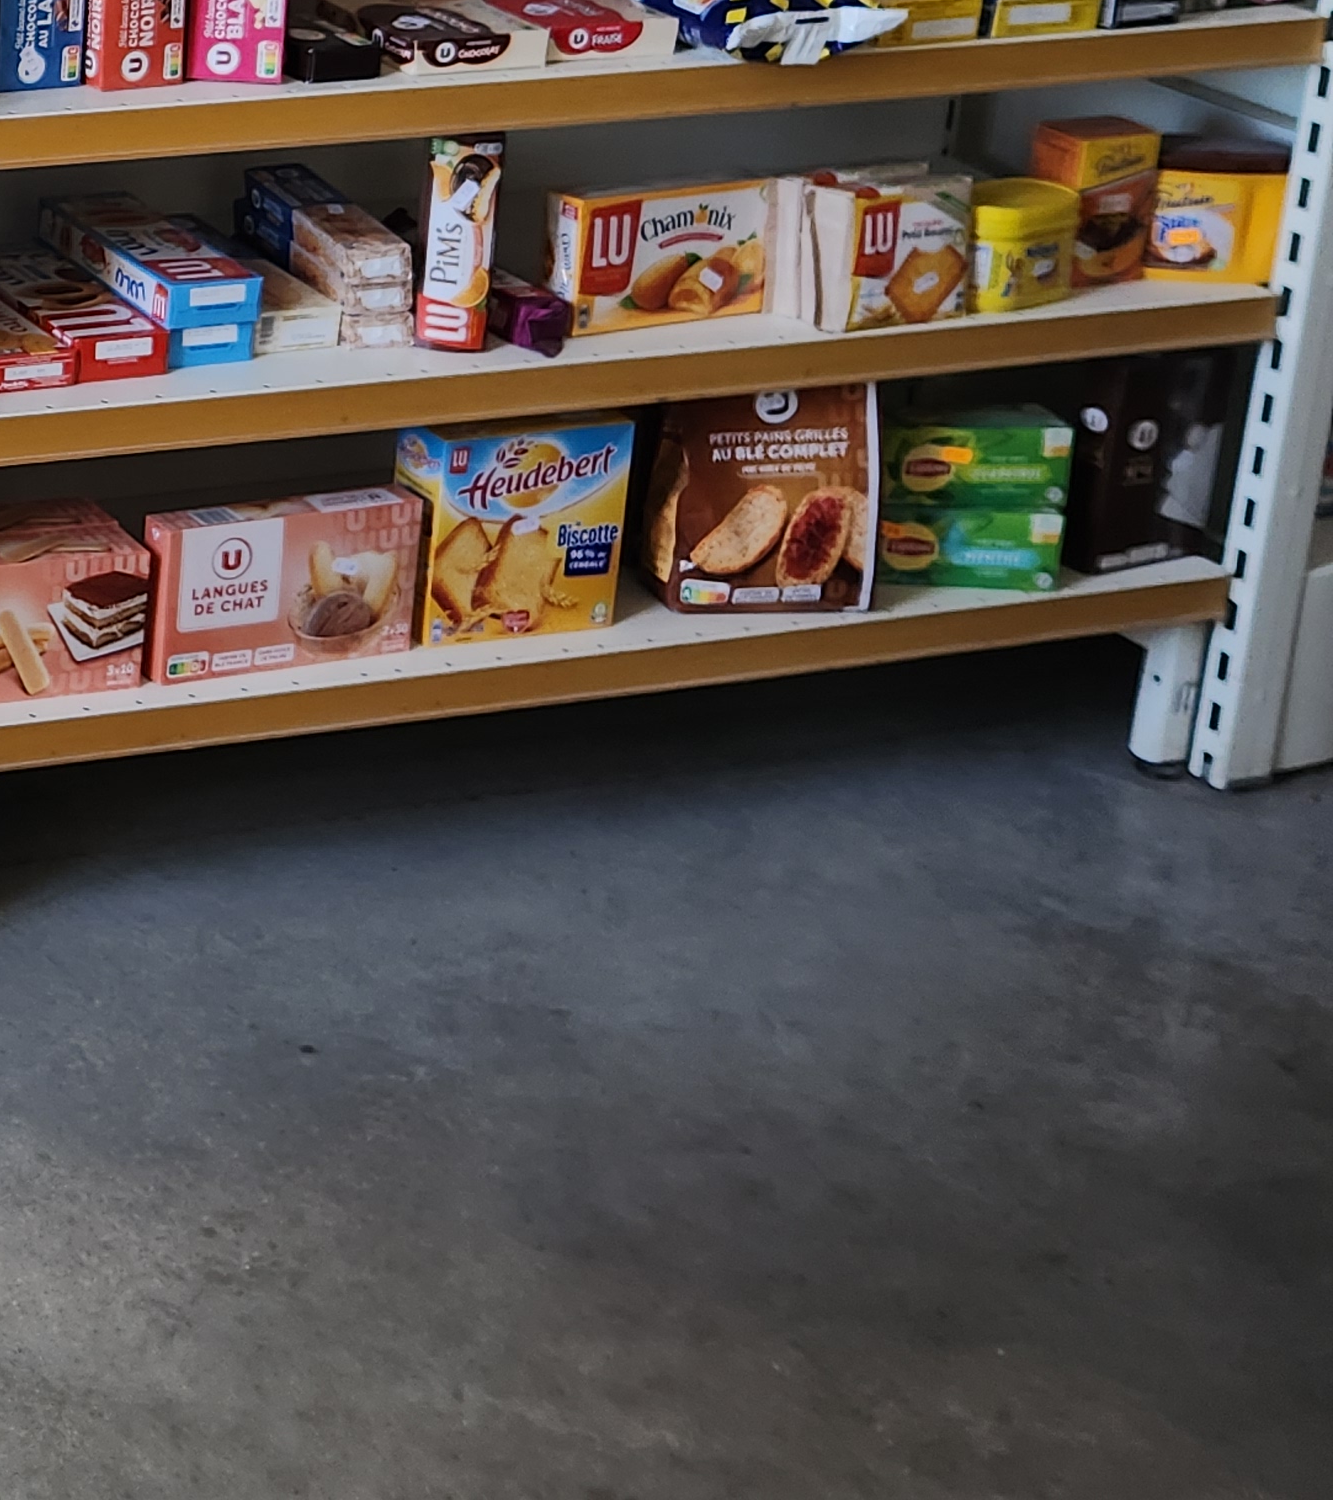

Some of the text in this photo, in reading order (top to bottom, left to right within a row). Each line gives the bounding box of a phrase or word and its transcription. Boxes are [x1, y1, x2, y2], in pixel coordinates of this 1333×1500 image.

[39, 27, 49, 48] AU
[591, 32, 623, 47] FRAISE
[457, 44, 500, 59] CHOCOLAT
[591, 213, 632, 268] LU
[864, 210, 894, 255] LU
[429, 221, 464, 286] PiM's
[424, 303, 468, 342] LU
[709, 426, 850, 445] PETITS PAINS GRILLÉS
[451, 449, 468, 470] LU
[712, 442, 849, 462] AU BLÉ COMPLET
[457, 444, 618, 511] Heudebert
[557, 522, 619, 548] Biscotte
[191, 579, 269, 601] LANGUES
[193, 595, 263, 617] DE CHAT
[106, 664, 134, 677] 3x10
